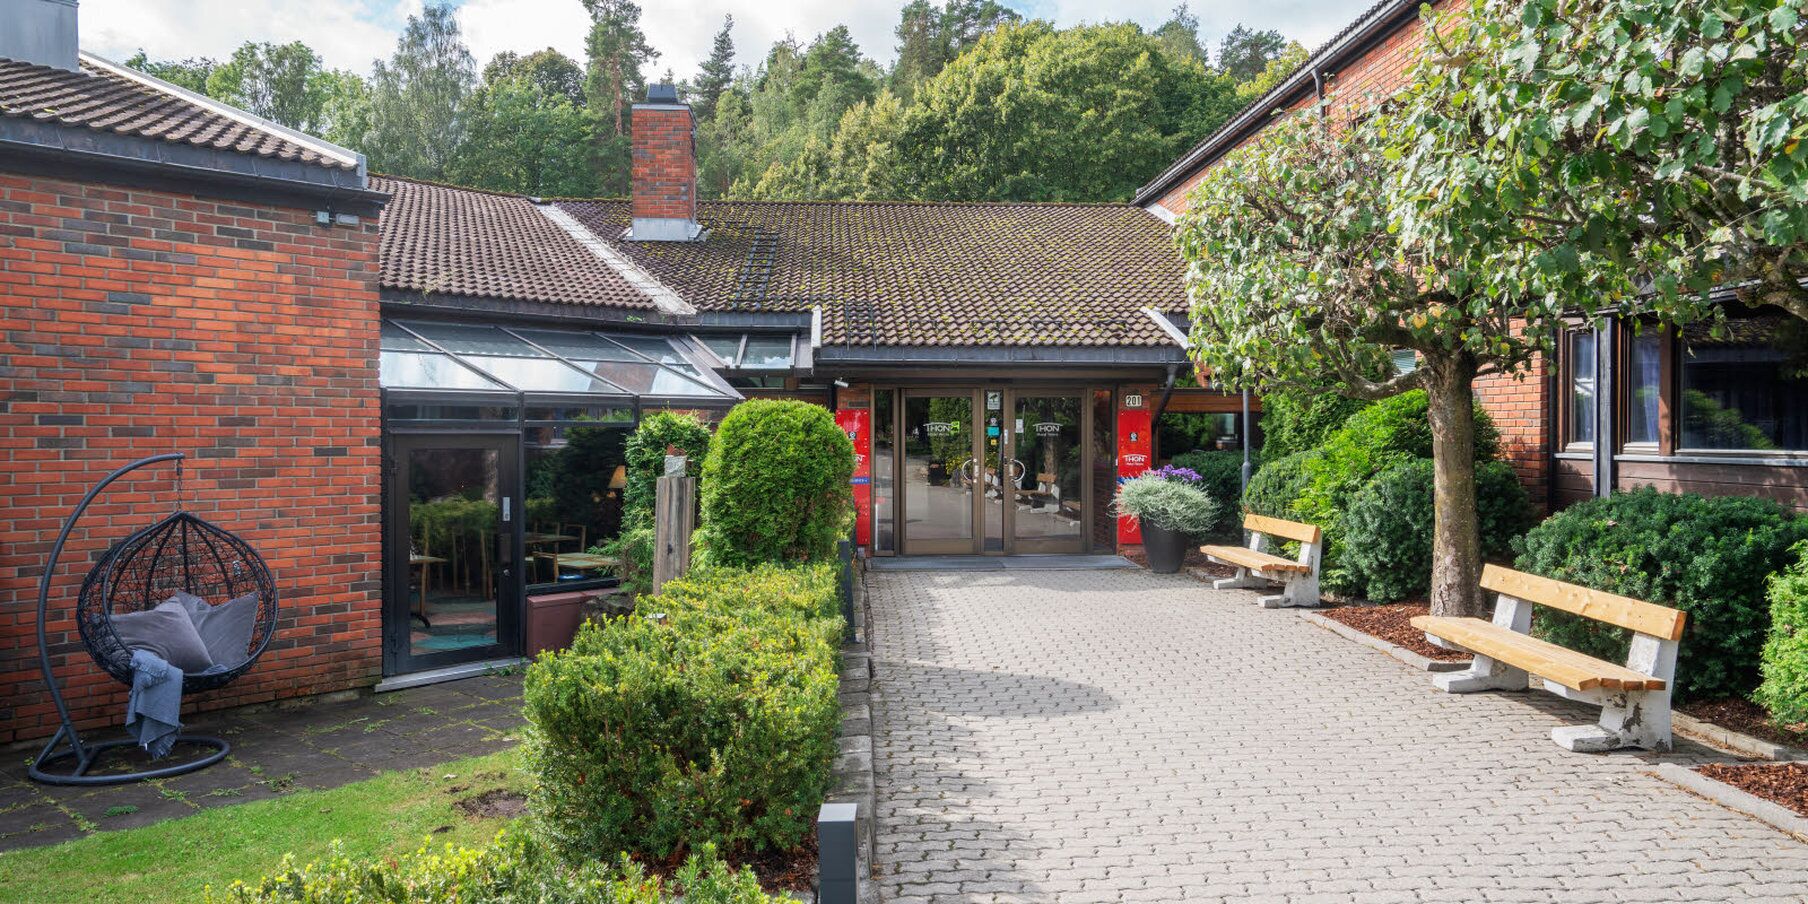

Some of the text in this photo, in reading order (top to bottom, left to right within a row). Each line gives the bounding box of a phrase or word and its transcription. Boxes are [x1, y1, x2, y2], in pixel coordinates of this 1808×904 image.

[1127, 396, 1141, 406] 201
[923, 422, 953, 433] THON
[1032, 422, 1063, 433] THON
[1122, 453, 1147, 463] THON
